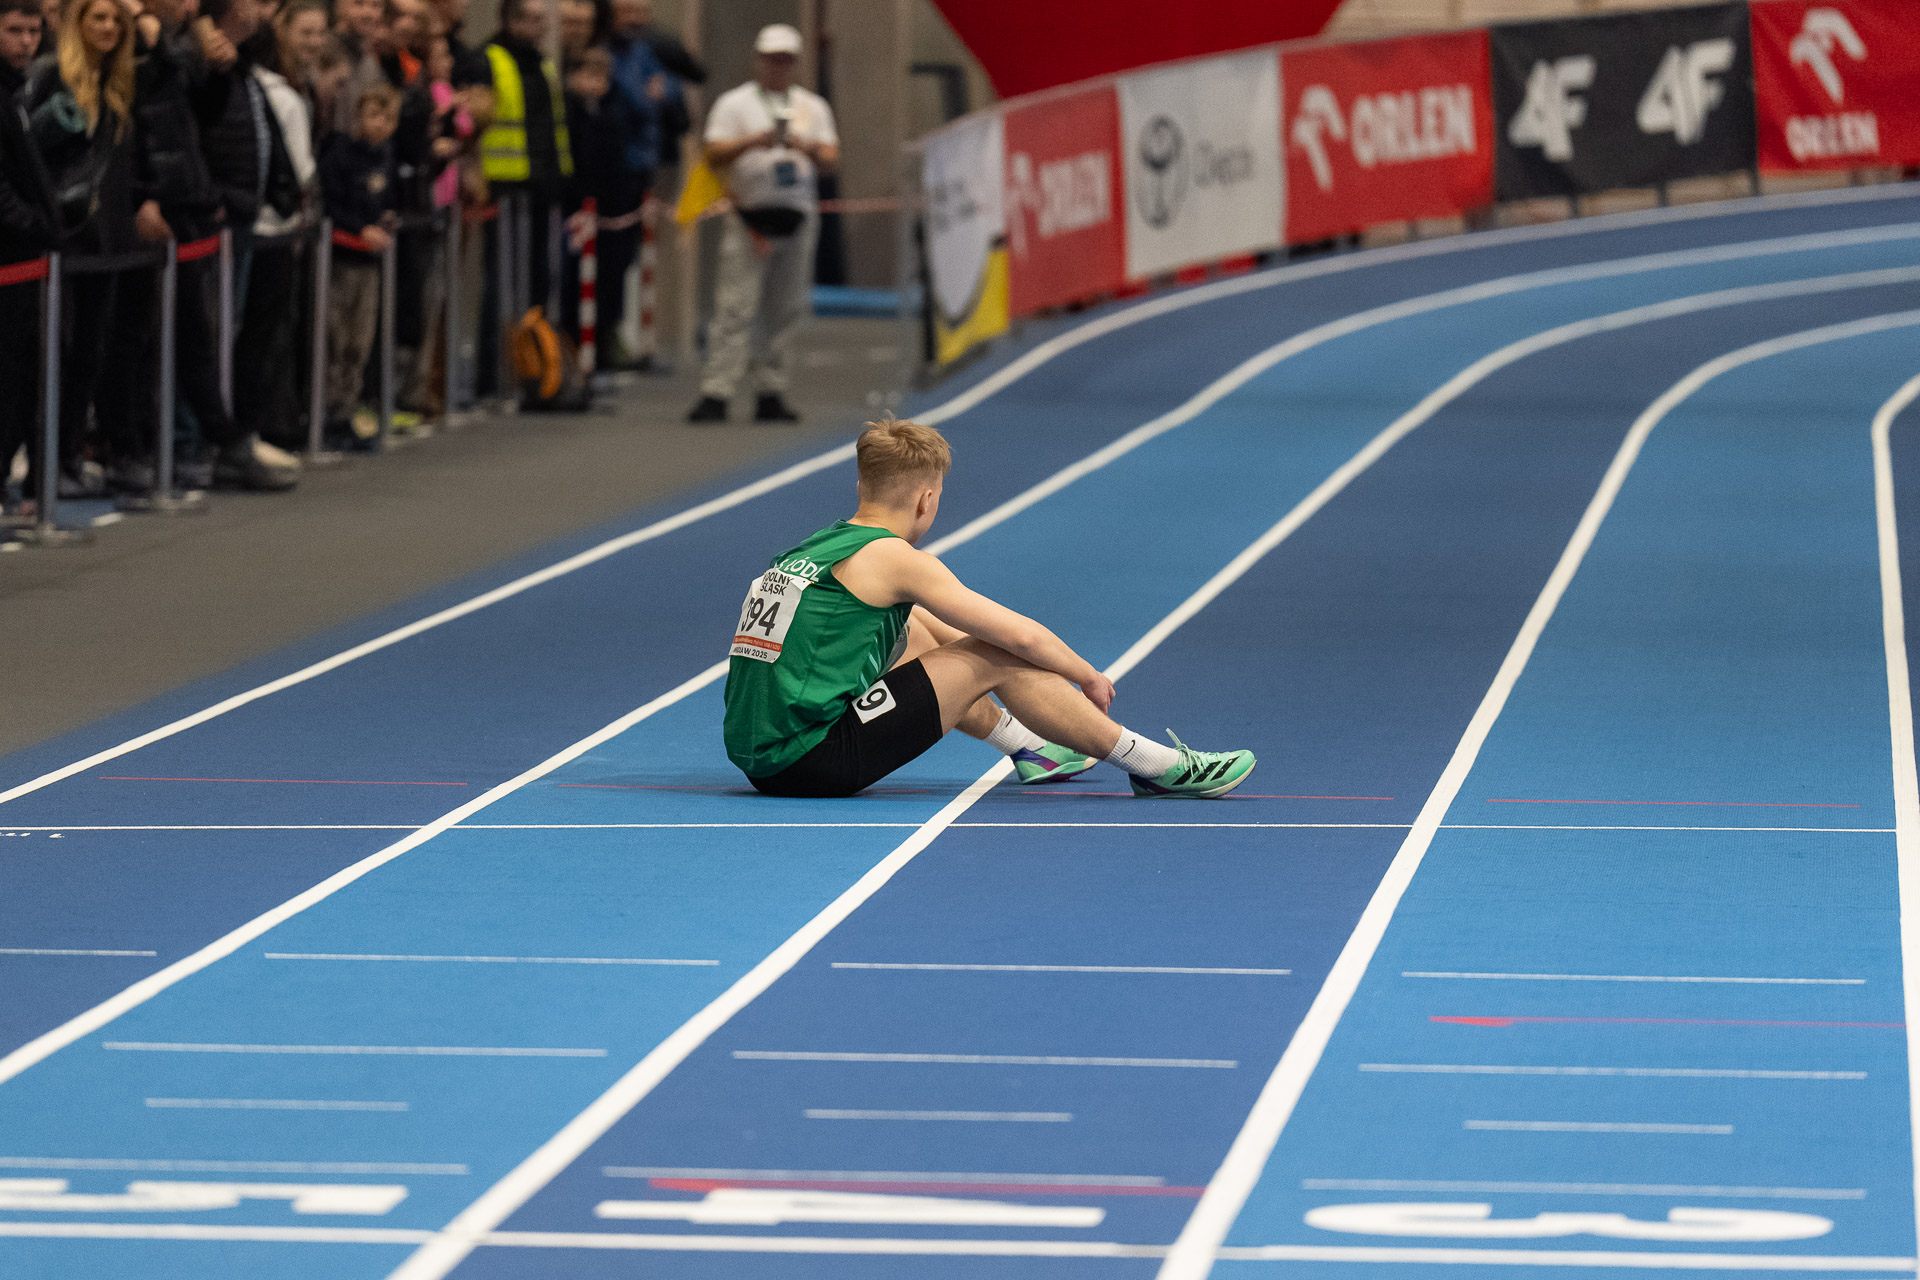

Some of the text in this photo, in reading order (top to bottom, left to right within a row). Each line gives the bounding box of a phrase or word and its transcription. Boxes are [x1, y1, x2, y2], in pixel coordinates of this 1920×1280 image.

[1352, 84, 1476, 168] ORLEN
[1508, 53, 1595, 161] 4F
[1636, 37, 1736, 146] 4F
[752, 649, 768, 659] 2025
[1303, 1201, 1834, 1242] 3
